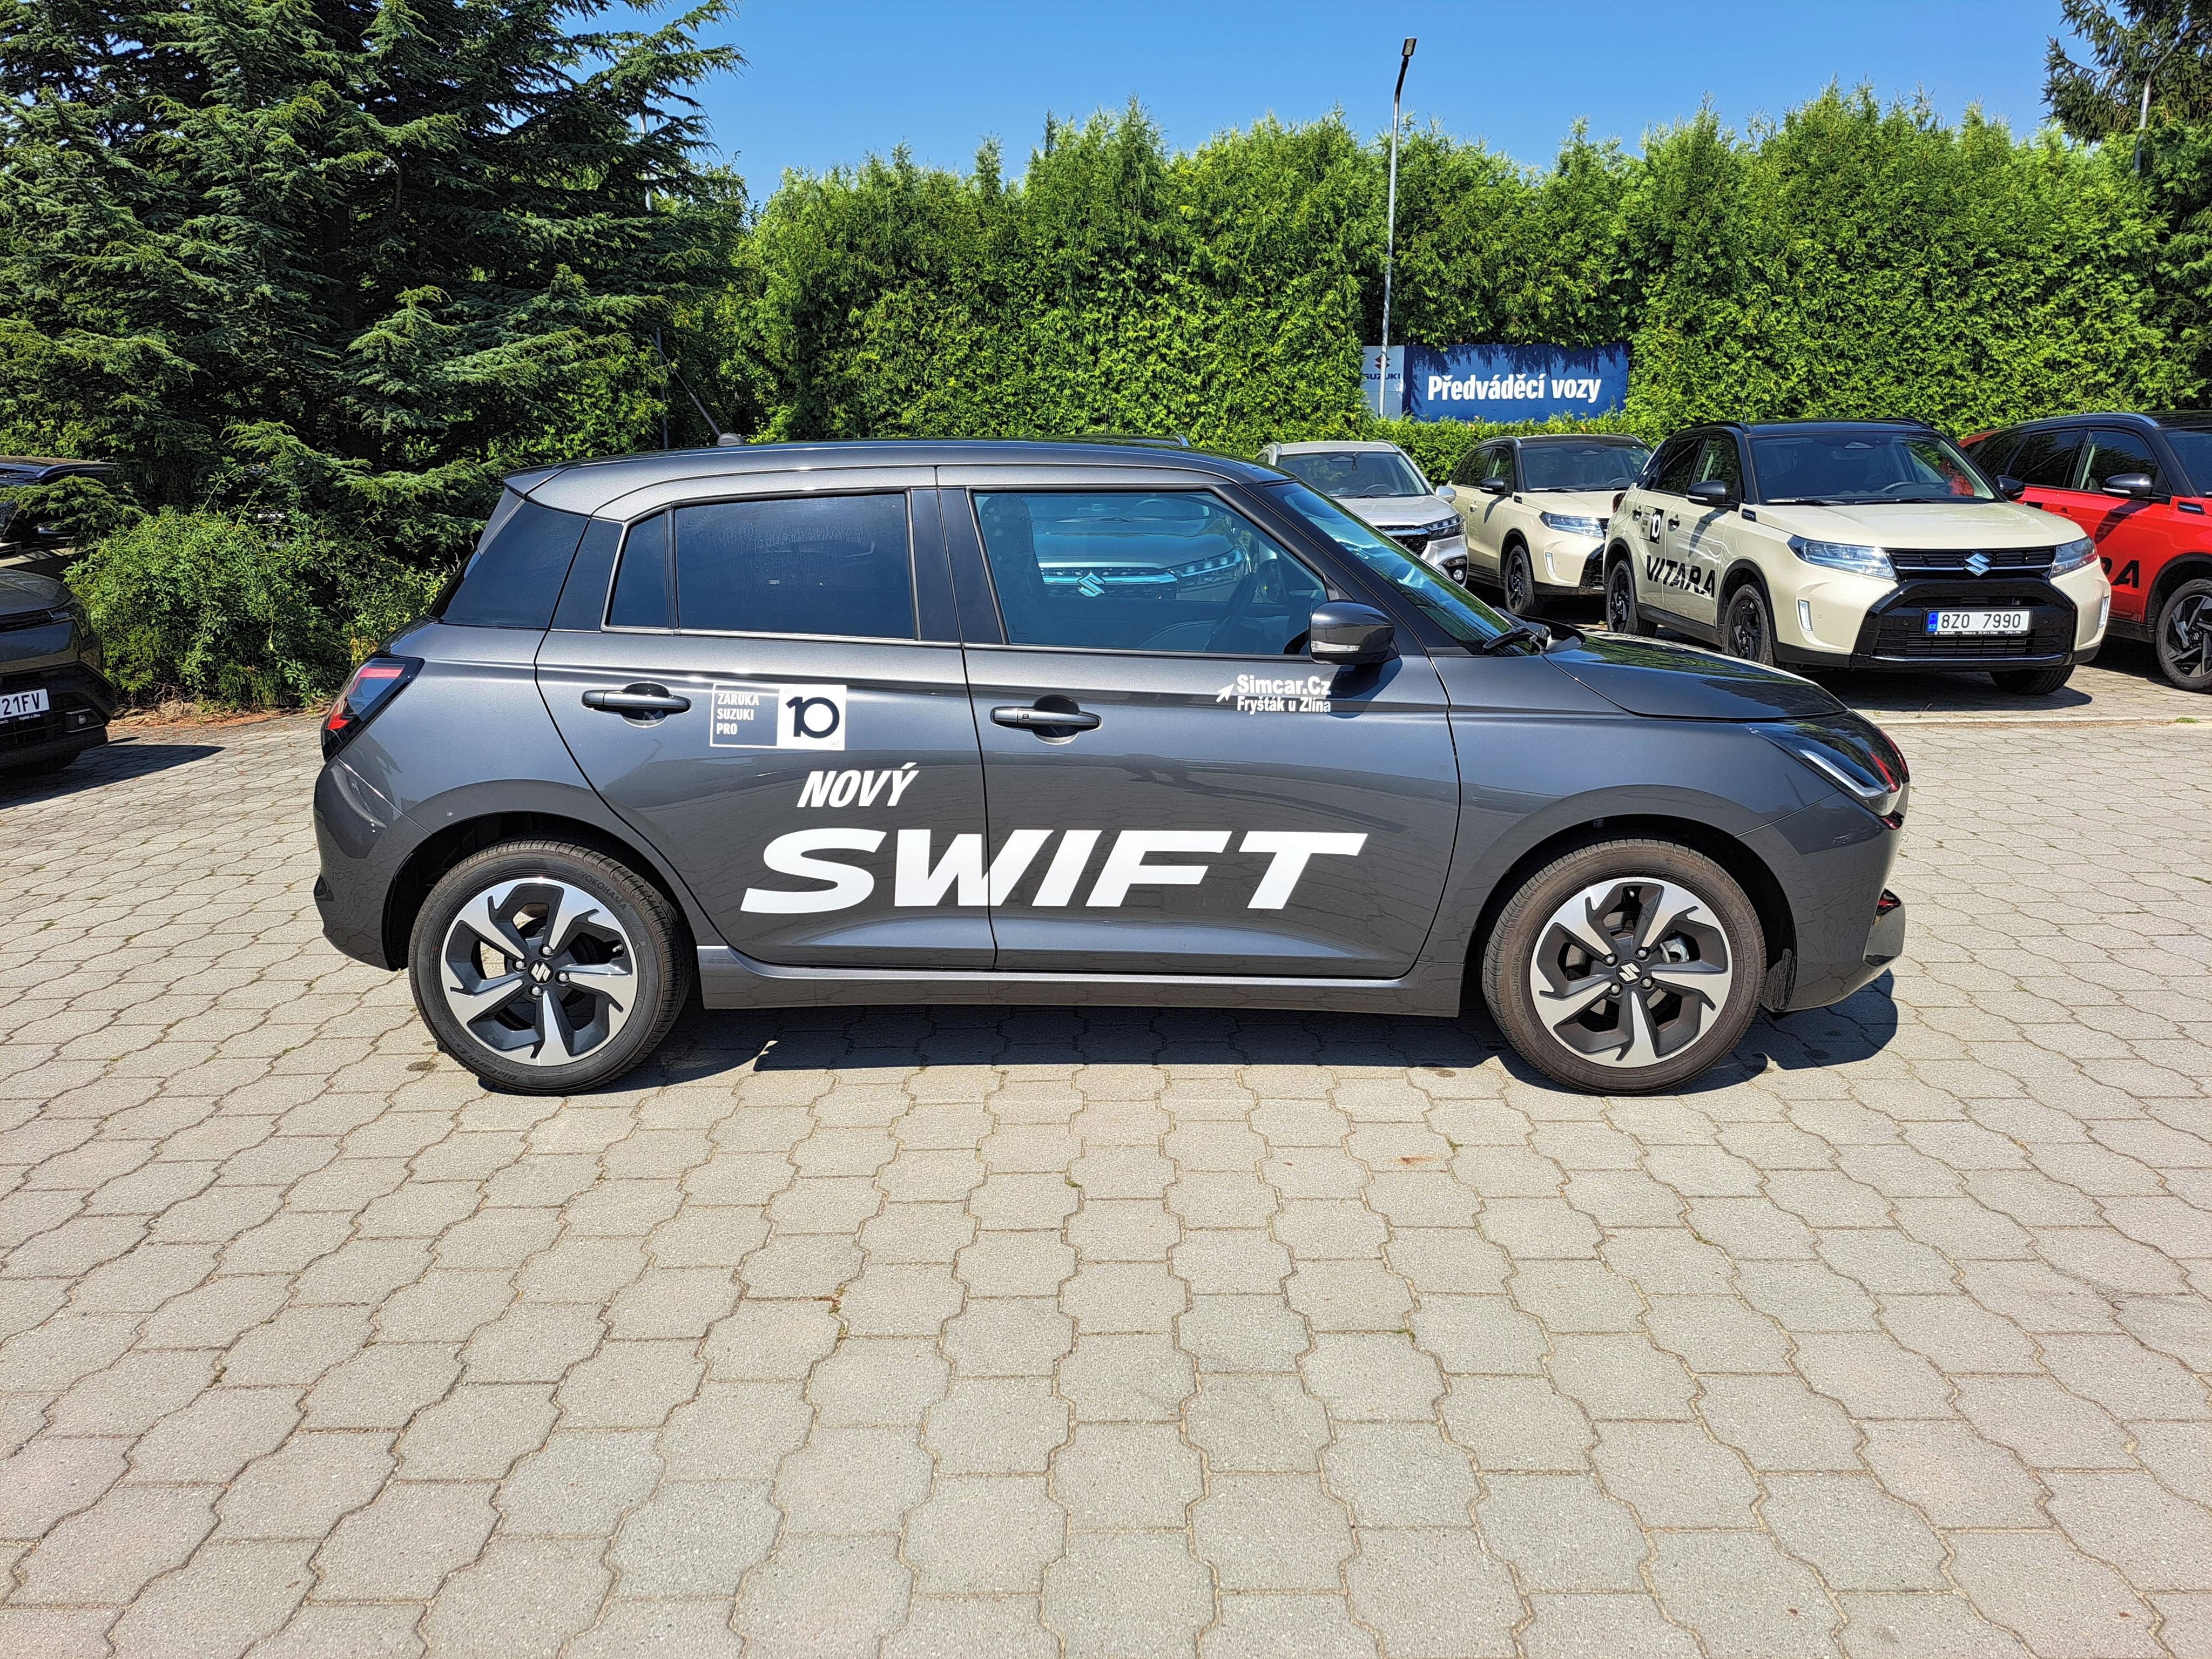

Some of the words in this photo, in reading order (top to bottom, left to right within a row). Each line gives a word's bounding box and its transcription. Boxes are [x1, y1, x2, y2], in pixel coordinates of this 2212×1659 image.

[1427, 373, 1545, 401] Předváděcí
[1552, 379, 1601, 403] vozy
[1647, 555, 1715, 598] VITARA
[1941, 613, 1970, 629] 8Z0
[1982, 613, 2021, 629] 7990
[1237, 675, 1331, 695] Simcar.Cz
[2, 692, 39, 716] 21FV
[717, 707, 754, 720] SUZUKI
[785, 696, 840, 739] 10
[1237, 696, 1285, 715] Fryšták
[1289, 700, 1296, 712] u
[1299, 697, 1331, 712] Zlína
[716, 723, 738, 735] PRO
[797, 762, 919, 808] NOVÝ
[740, 828, 1368, 914] SWIFT
[581, 871, 627, 910] YOKOHAMA
